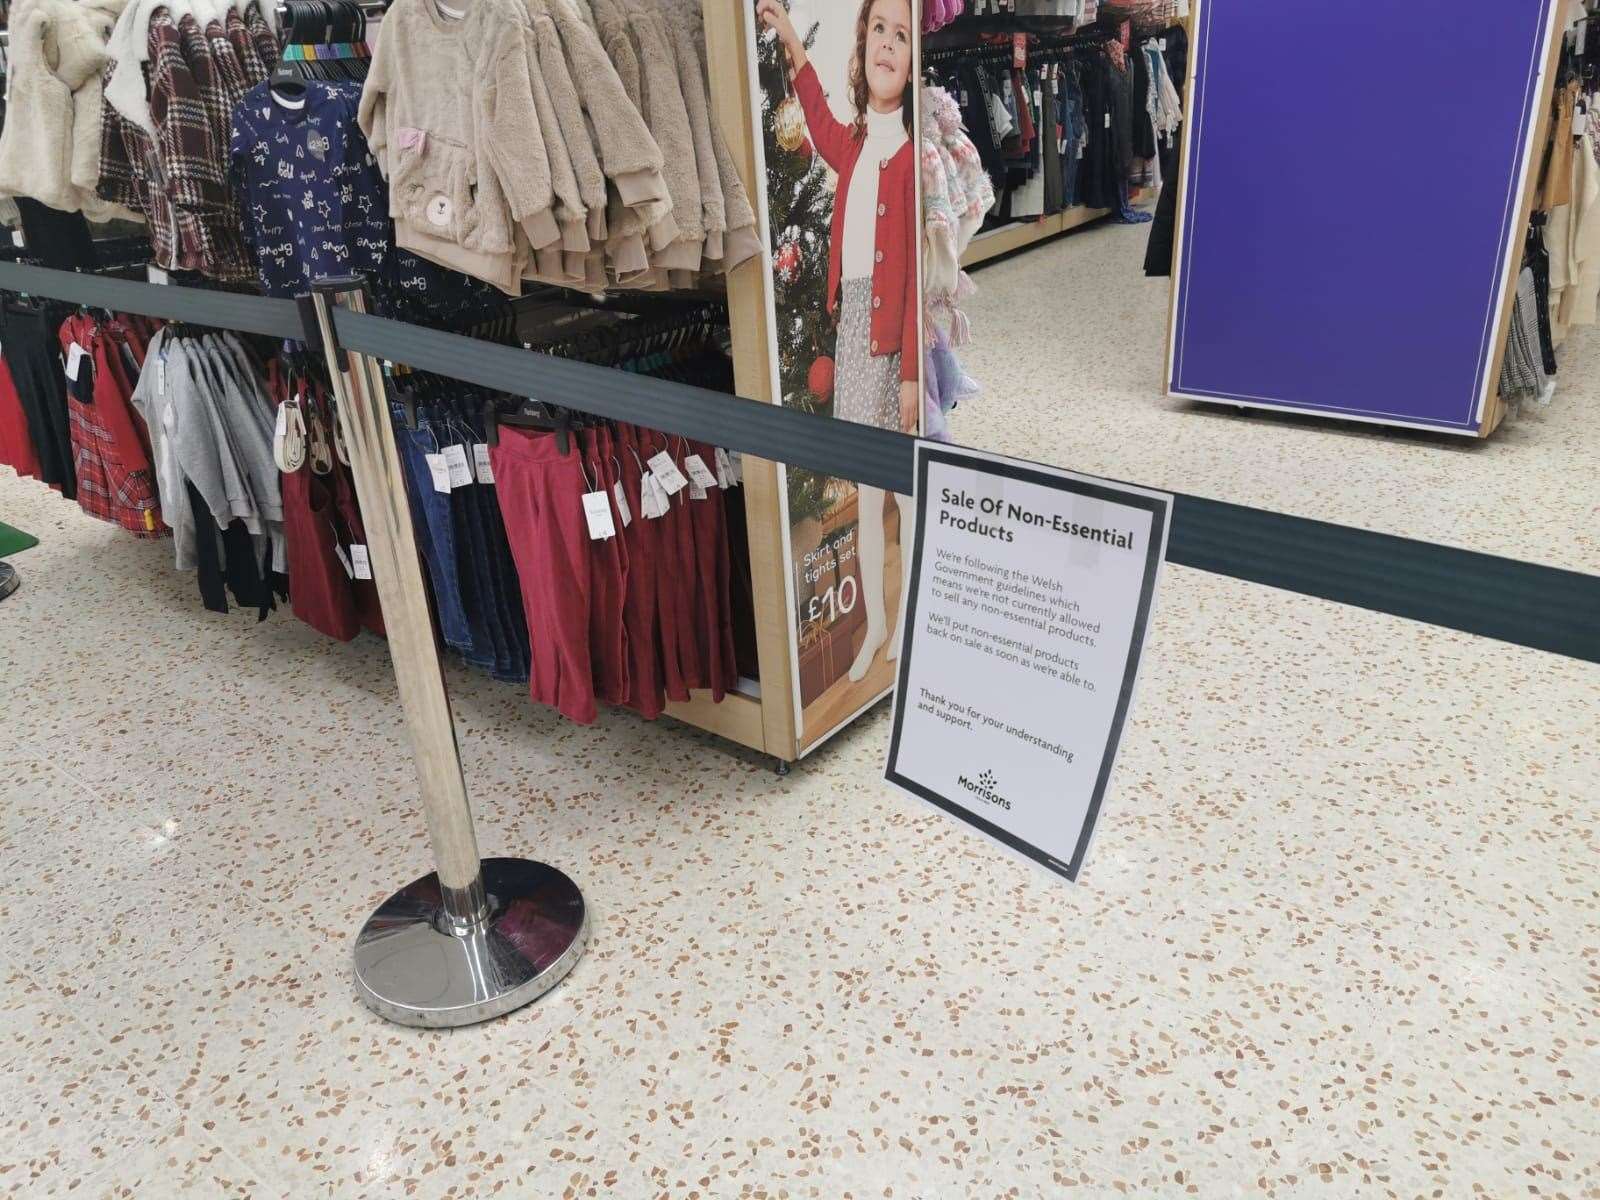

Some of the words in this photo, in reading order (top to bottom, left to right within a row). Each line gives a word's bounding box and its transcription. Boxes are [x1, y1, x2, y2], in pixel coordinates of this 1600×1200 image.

[940, 510, 1014, 542] Products
[941, 488, 975, 509] Sale
[980, 498, 1004, 516] Of
[1007, 503, 1133, 550] Non-Essential
[803, 543, 831, 567] Skirt
[833, 527, 854, 550] and
[804, 560, 837, 584] tights
[839, 547, 857, 563] set
[936, 548, 962, 563] We're
[965, 555, 1009, 580] following
[1012, 569, 1029, 582] the
[1032, 575, 1063, 592] Welsh
[808, 575, 857, 622] £10
[932, 576, 963, 591] means
[965, 585, 990, 599] we're
[992, 593, 1009, 605] not
[1011, 600, 1057, 621] currently
[1059, 613, 1101, 634] allowed
[934, 561, 994, 586] Government
[996, 581, 1046, 602] guidelines
[1049, 596, 1080, 612] which
[928, 611, 951, 626] We'll
[952, 621, 969, 632] put
[970, 626, 1034, 654] non-essential
[1034, 649, 1080, 671] products
[931, 588, 942, 598] to
[944, 592, 960, 604] sell
[962, 598, 978, 611] any
[981, 603, 1046, 630] non-essential
[1048, 625, 1097, 648] products.
[927, 623, 949, 639] back
[950, 633, 962, 643] on
[964, 638, 982, 650] sale
[983, 645, 993, 655] as
[995, 648, 1019, 662] soon
[1020, 658, 1030, 668] as
[1060, 671, 1081, 686] able
[918, 702, 934, 714] and
[936, 709, 973, 731] support.
[920, 687, 946, 706] Thank
[948, 701, 965, 714] you
[967, 706, 981, 720] for
[982, 714, 1004, 729] your
[1006, 725, 1074, 763] understanding
[957, 775, 1012, 811] Morrisons
